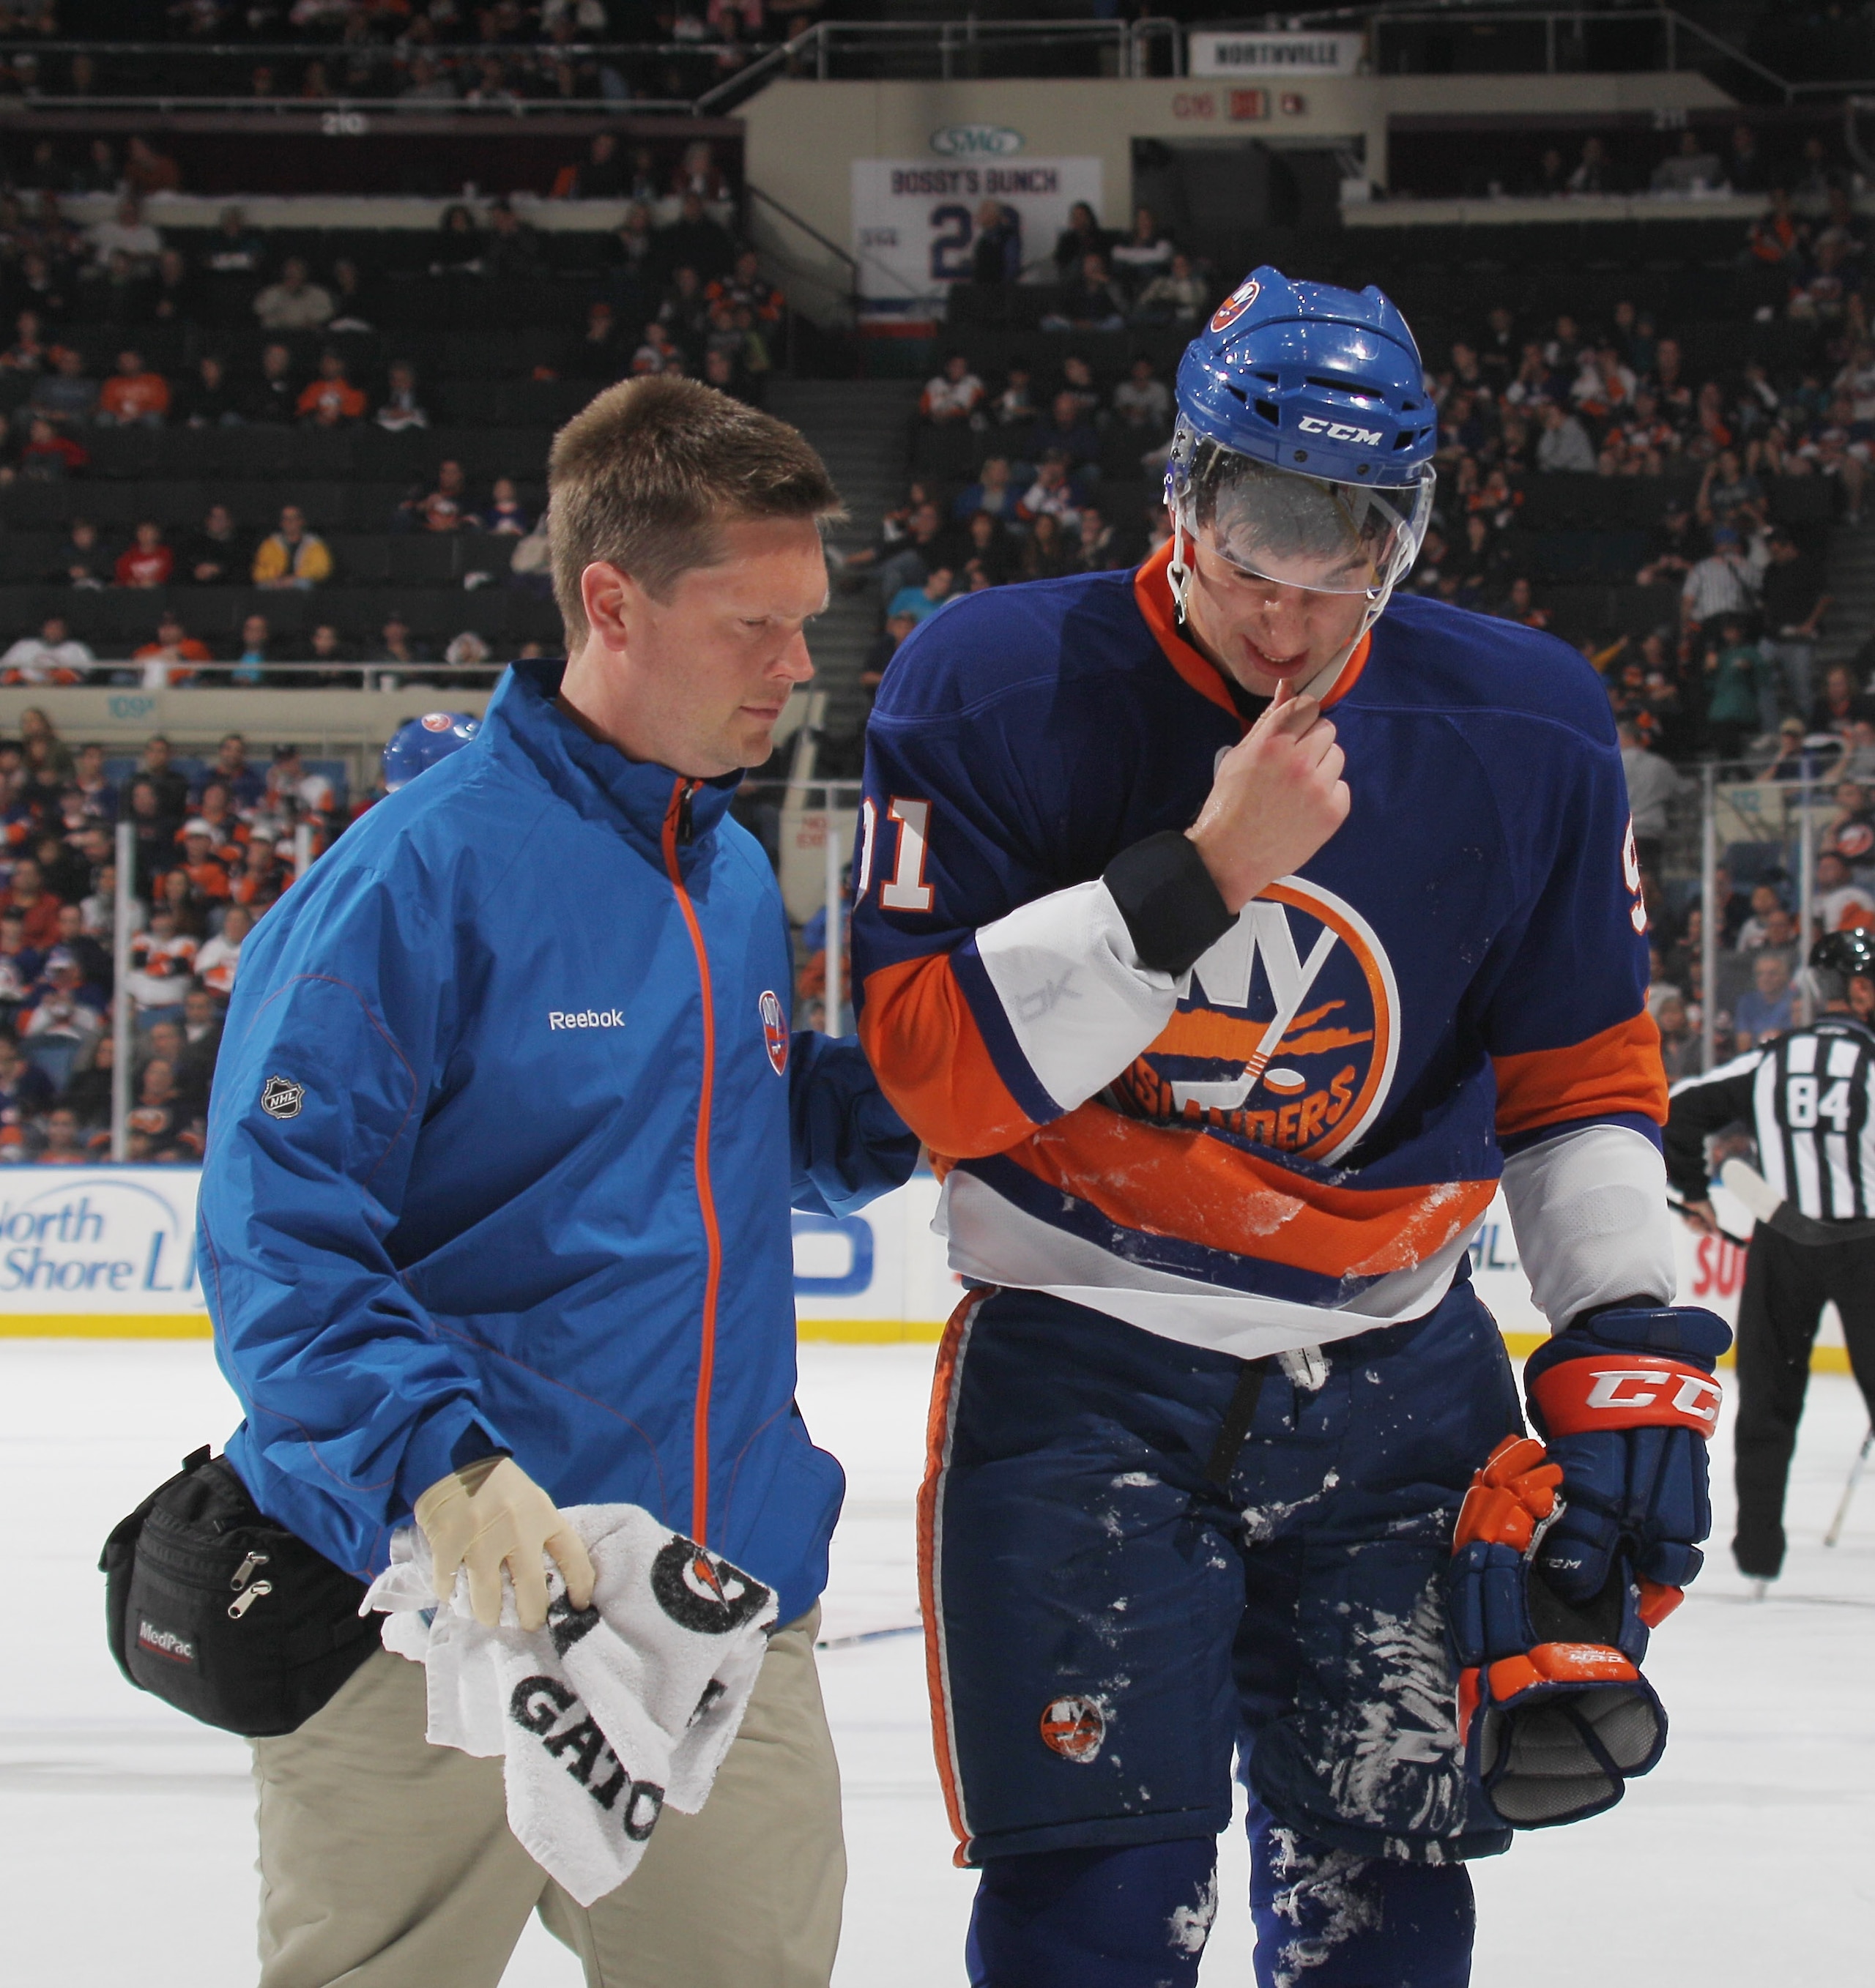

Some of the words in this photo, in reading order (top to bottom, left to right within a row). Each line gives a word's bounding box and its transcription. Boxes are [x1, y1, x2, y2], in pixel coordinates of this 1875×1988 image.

[891, 168, 980, 196] BOSSY'S
[985, 167, 1058, 195] BUNCH
[1298, 415, 1384, 446] CCM
[549, 1008, 626, 1031] Reebok
[270, 1092, 296, 1108] NHL
[1786, 1074, 1851, 1131] 84
[0, 1196, 104, 1243] orth
[1, 1246, 134, 1292] Shore
[1693, 1233, 1754, 1299] SU
[1585, 1370, 1723, 1426] CC
[139, 1620, 193, 1658] MedPac
